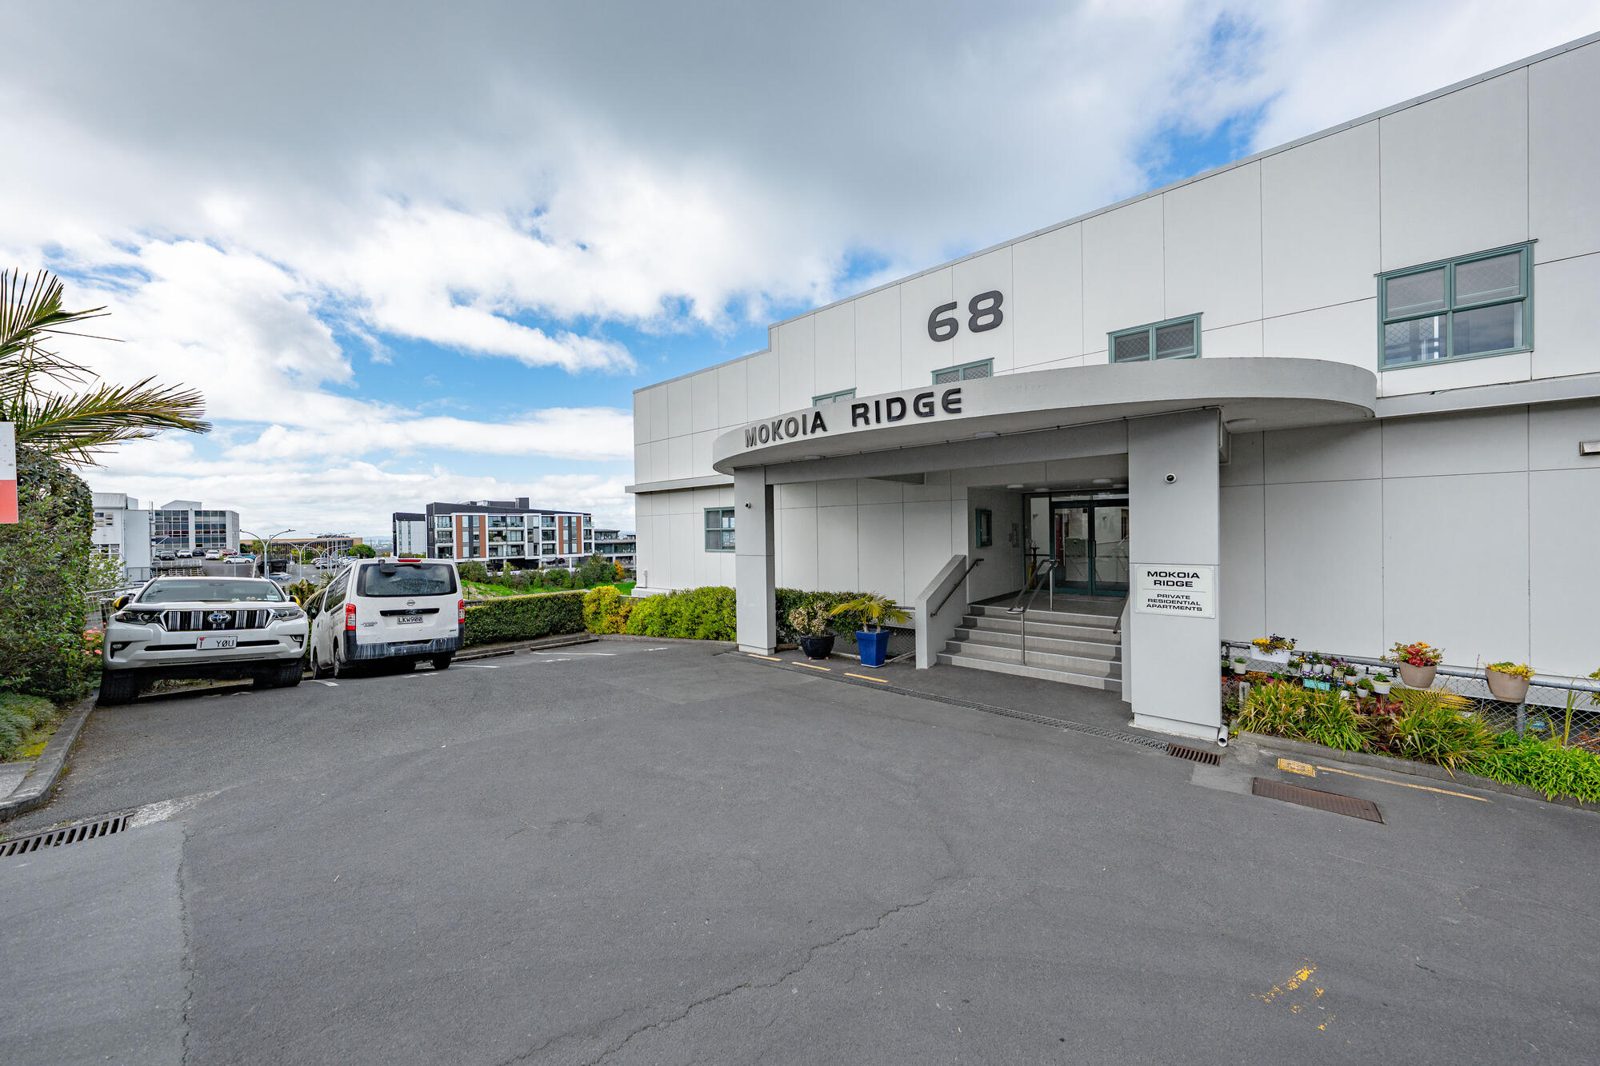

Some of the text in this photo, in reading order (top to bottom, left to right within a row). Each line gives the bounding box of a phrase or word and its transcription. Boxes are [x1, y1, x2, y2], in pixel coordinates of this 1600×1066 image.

[928, 290, 1004, 342] 68
[745, 388, 962, 448] MOKOIA RIDGE
[1147, 571, 1200, 579] MOKOIA
[1153, 579, 1194, 588] RIDGE
[1147, 598, 1201, 606] RESIDENTIAL
[1146, 603, 1203, 612] APARTMENTS
